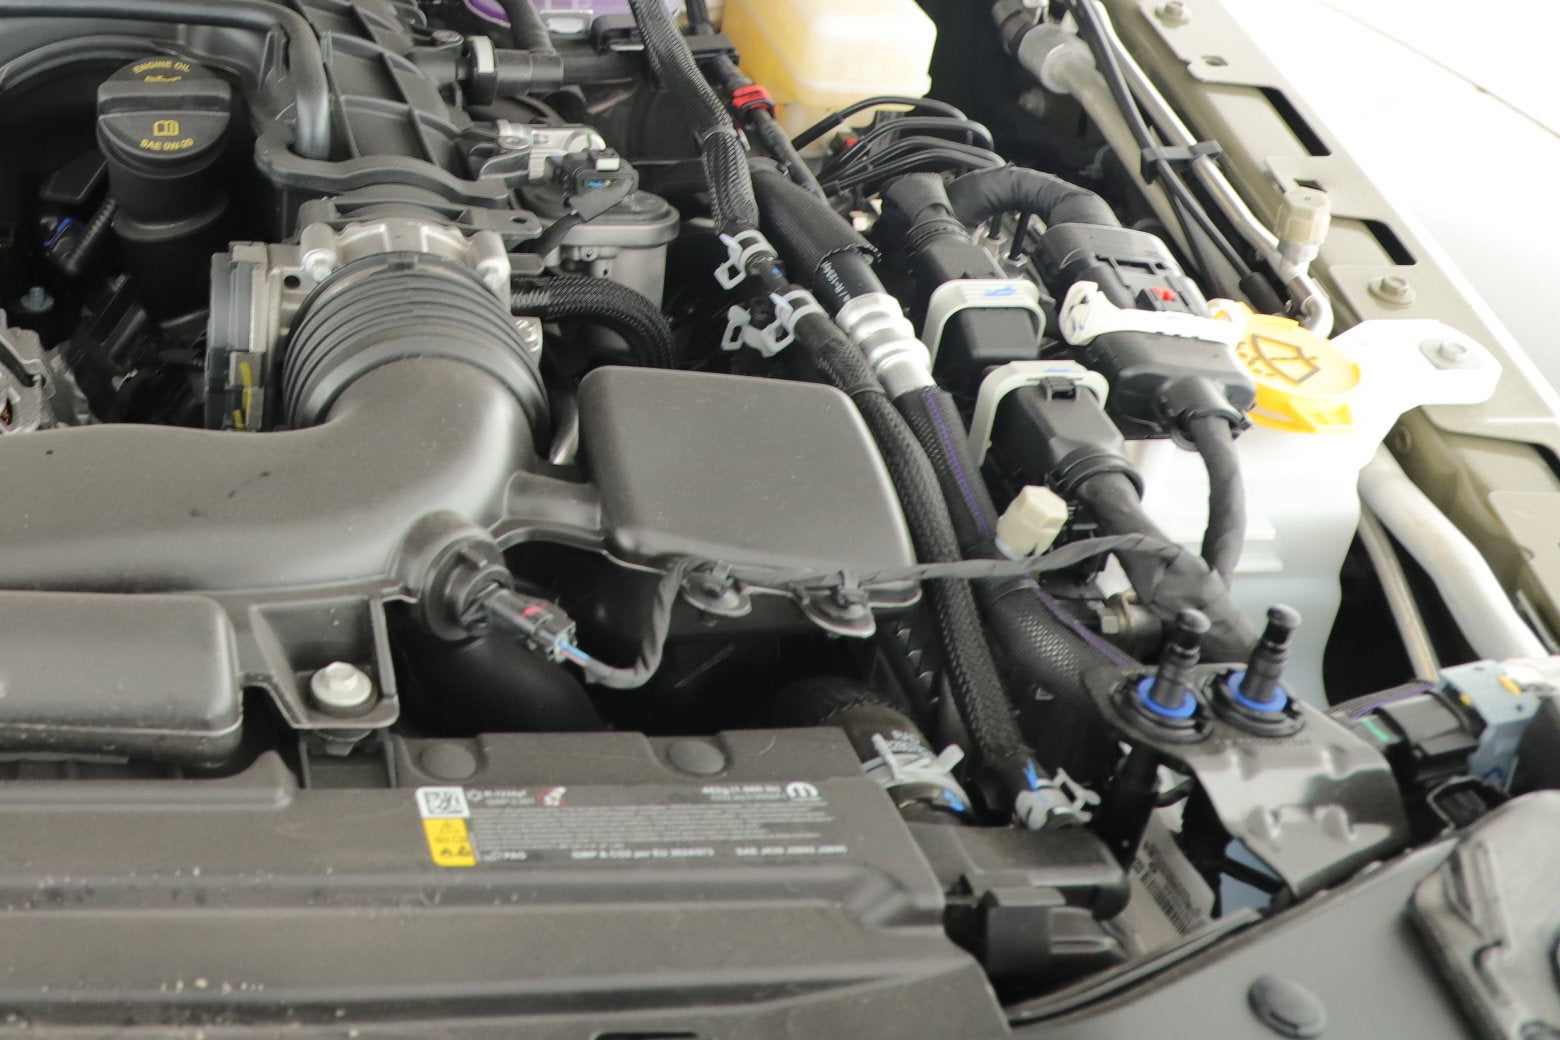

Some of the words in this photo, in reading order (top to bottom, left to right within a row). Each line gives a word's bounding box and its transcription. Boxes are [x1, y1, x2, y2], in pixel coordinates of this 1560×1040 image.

[132, 60, 173, 74] ENGINE
[173, 61, 191, 73] OIL
[139, 138, 163, 151] SAE
[162, 137, 194, 151] 0W-20
